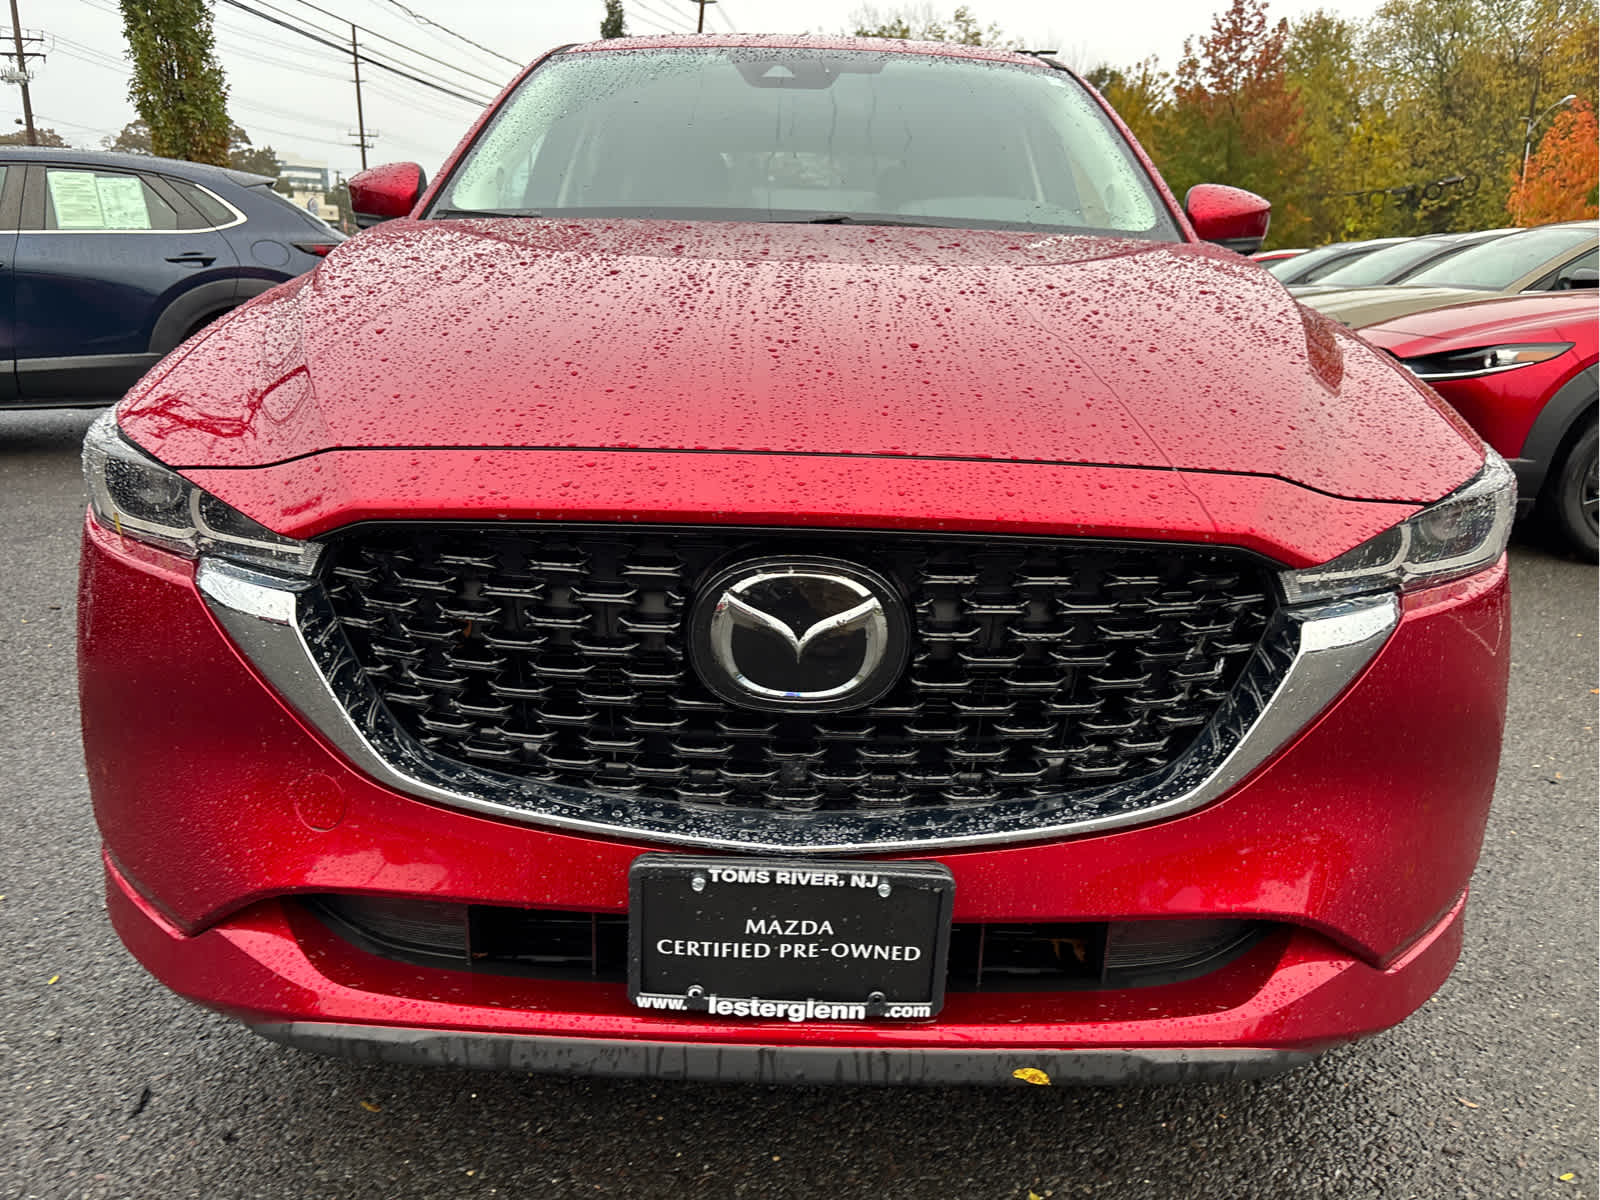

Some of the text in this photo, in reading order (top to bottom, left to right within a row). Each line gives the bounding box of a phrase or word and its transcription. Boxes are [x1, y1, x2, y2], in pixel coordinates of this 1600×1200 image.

[708, 868, 879, 889] TOMS RIVER, NJ
[744, 918, 835, 936] MAZDA
[656, 938, 922, 962] CERTIFIED PRE-OWNED
[635, 994, 931, 1022] www. lesterglenn .com
